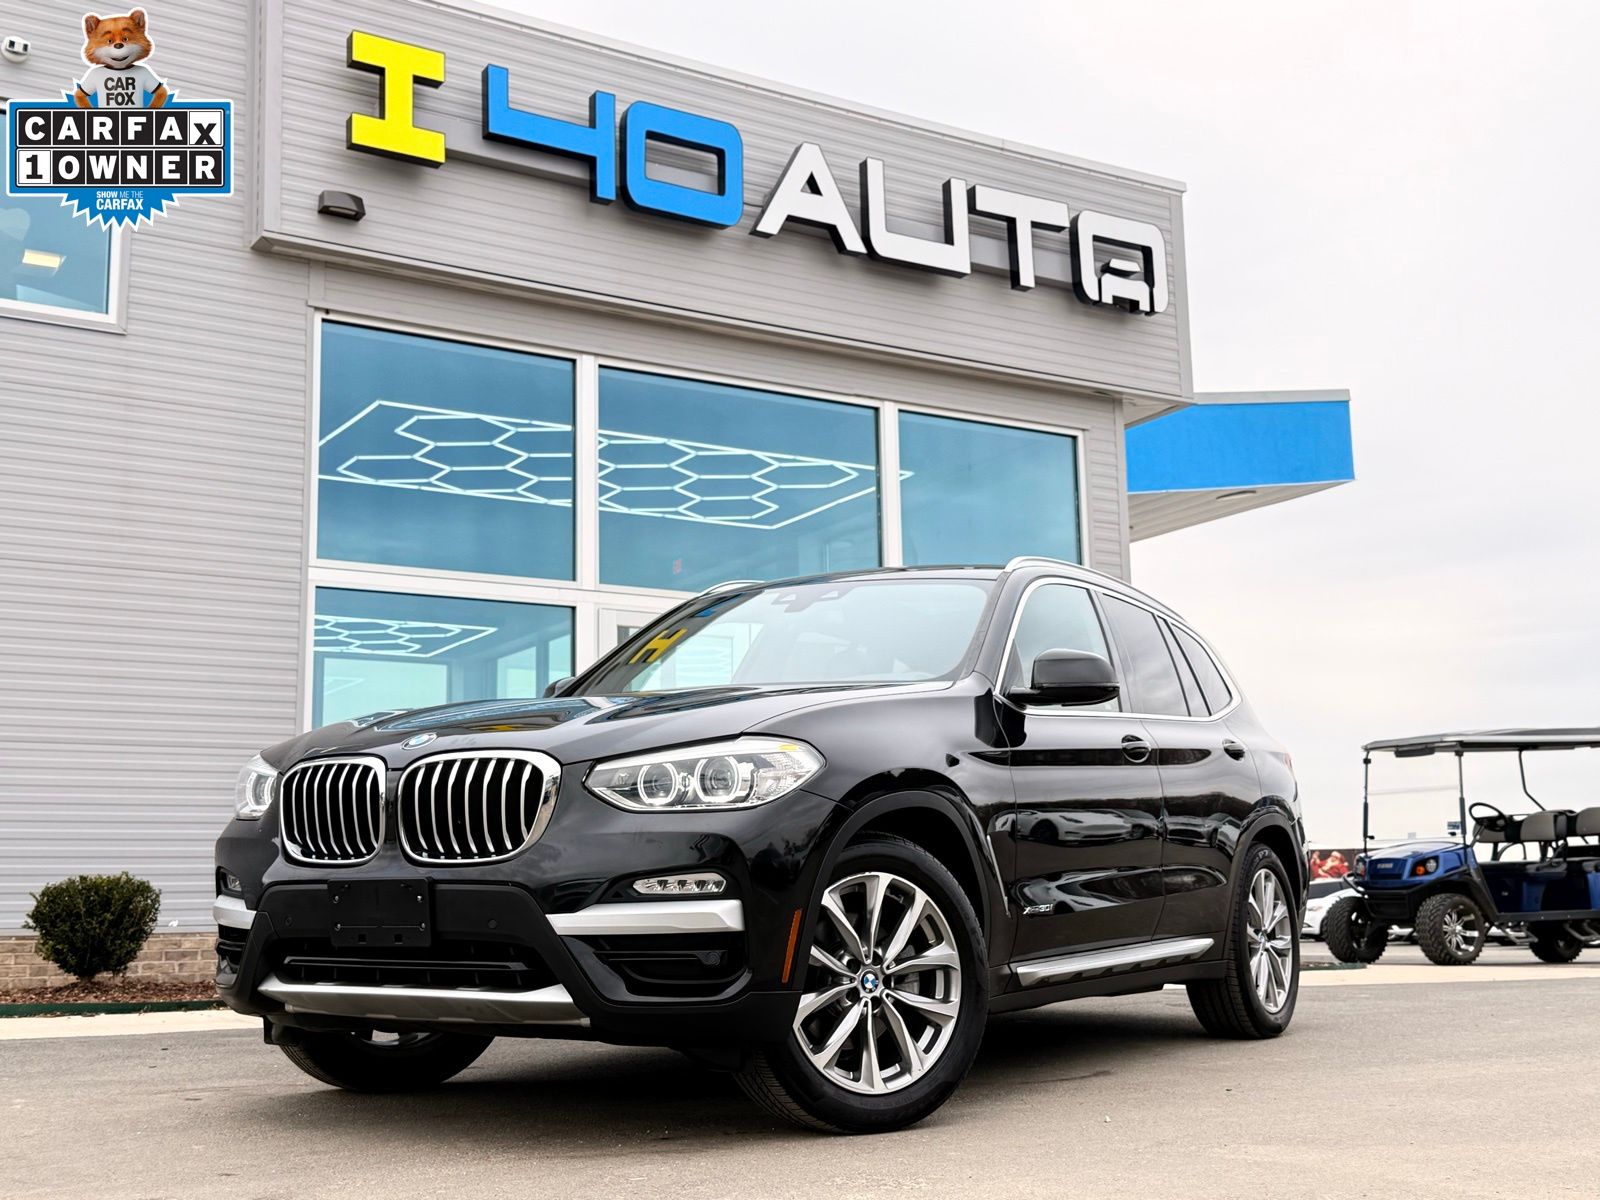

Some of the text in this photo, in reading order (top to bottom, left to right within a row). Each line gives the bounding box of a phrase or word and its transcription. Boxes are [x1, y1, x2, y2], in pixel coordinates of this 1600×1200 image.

[346, 29, 1168, 315] I 40 AUTO
